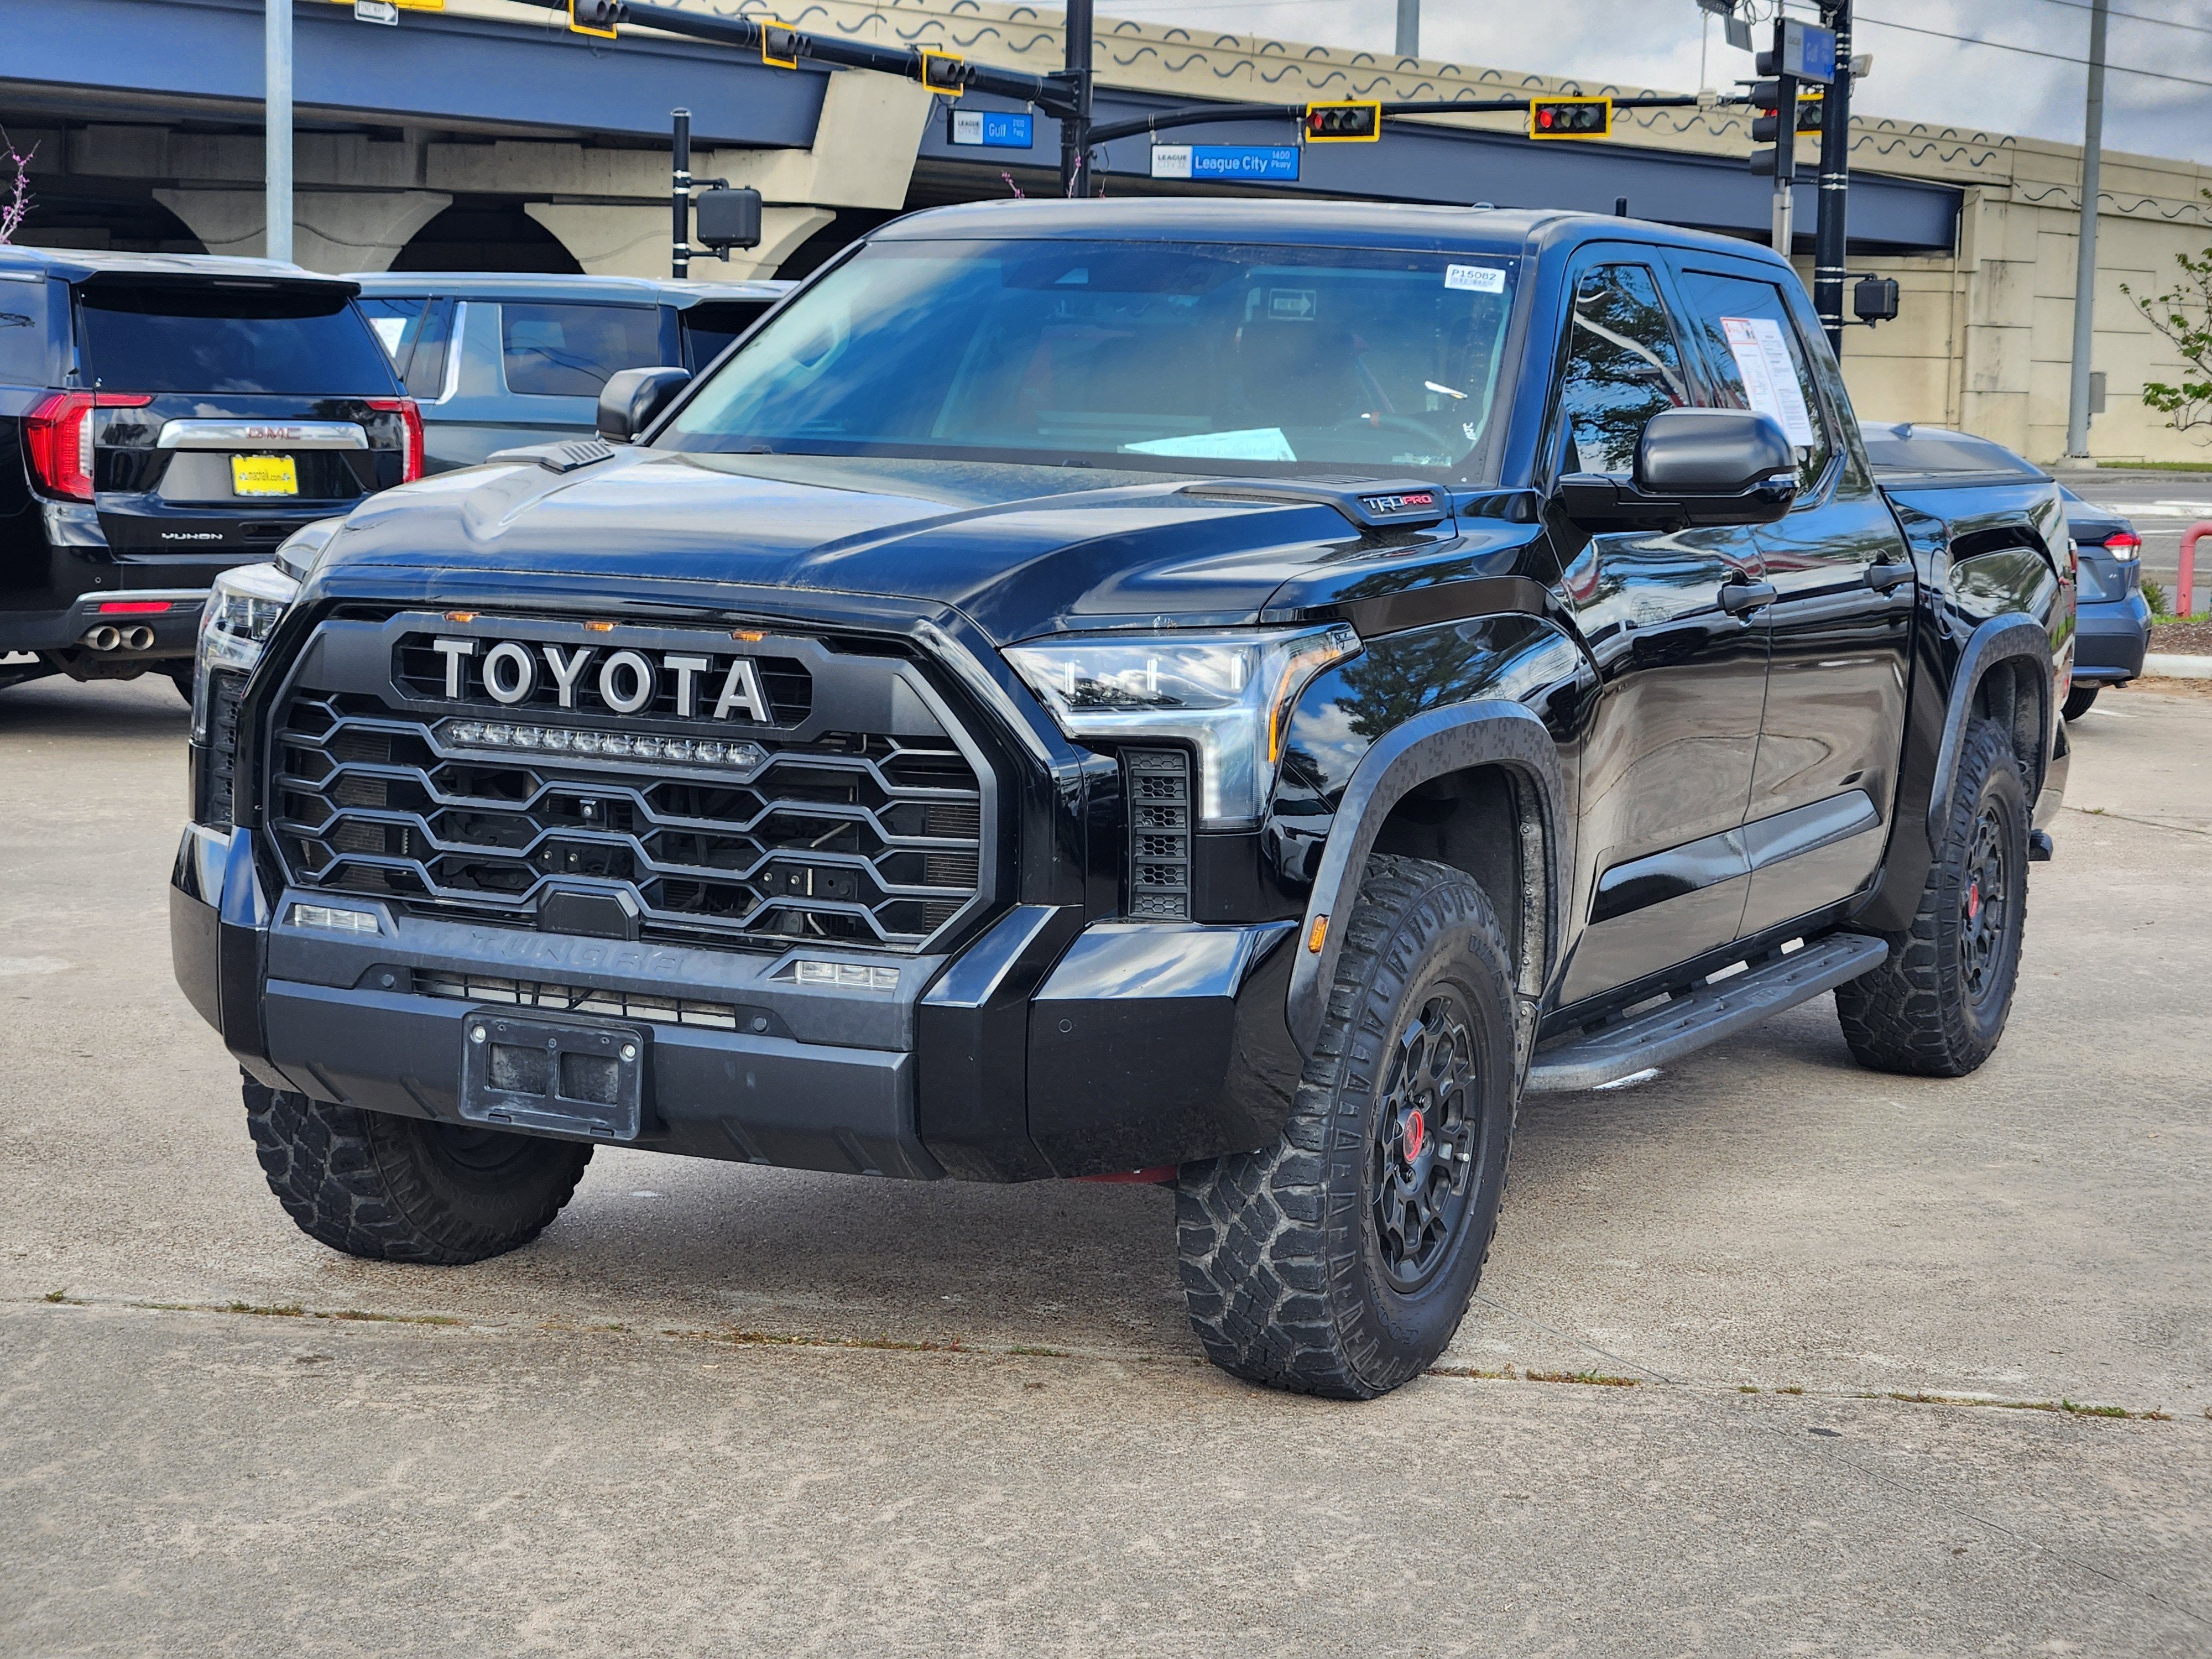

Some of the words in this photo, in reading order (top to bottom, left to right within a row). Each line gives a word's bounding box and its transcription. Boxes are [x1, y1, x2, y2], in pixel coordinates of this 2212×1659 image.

[1272, 150, 1290, 160] 1400
[1195, 155, 1240, 173] League
[1242, 156, 1268, 173] City
[1452, 269, 1496, 280] P15082
[247, 427, 301, 440] GMC
[434, 639, 768, 723] TOYOTA
